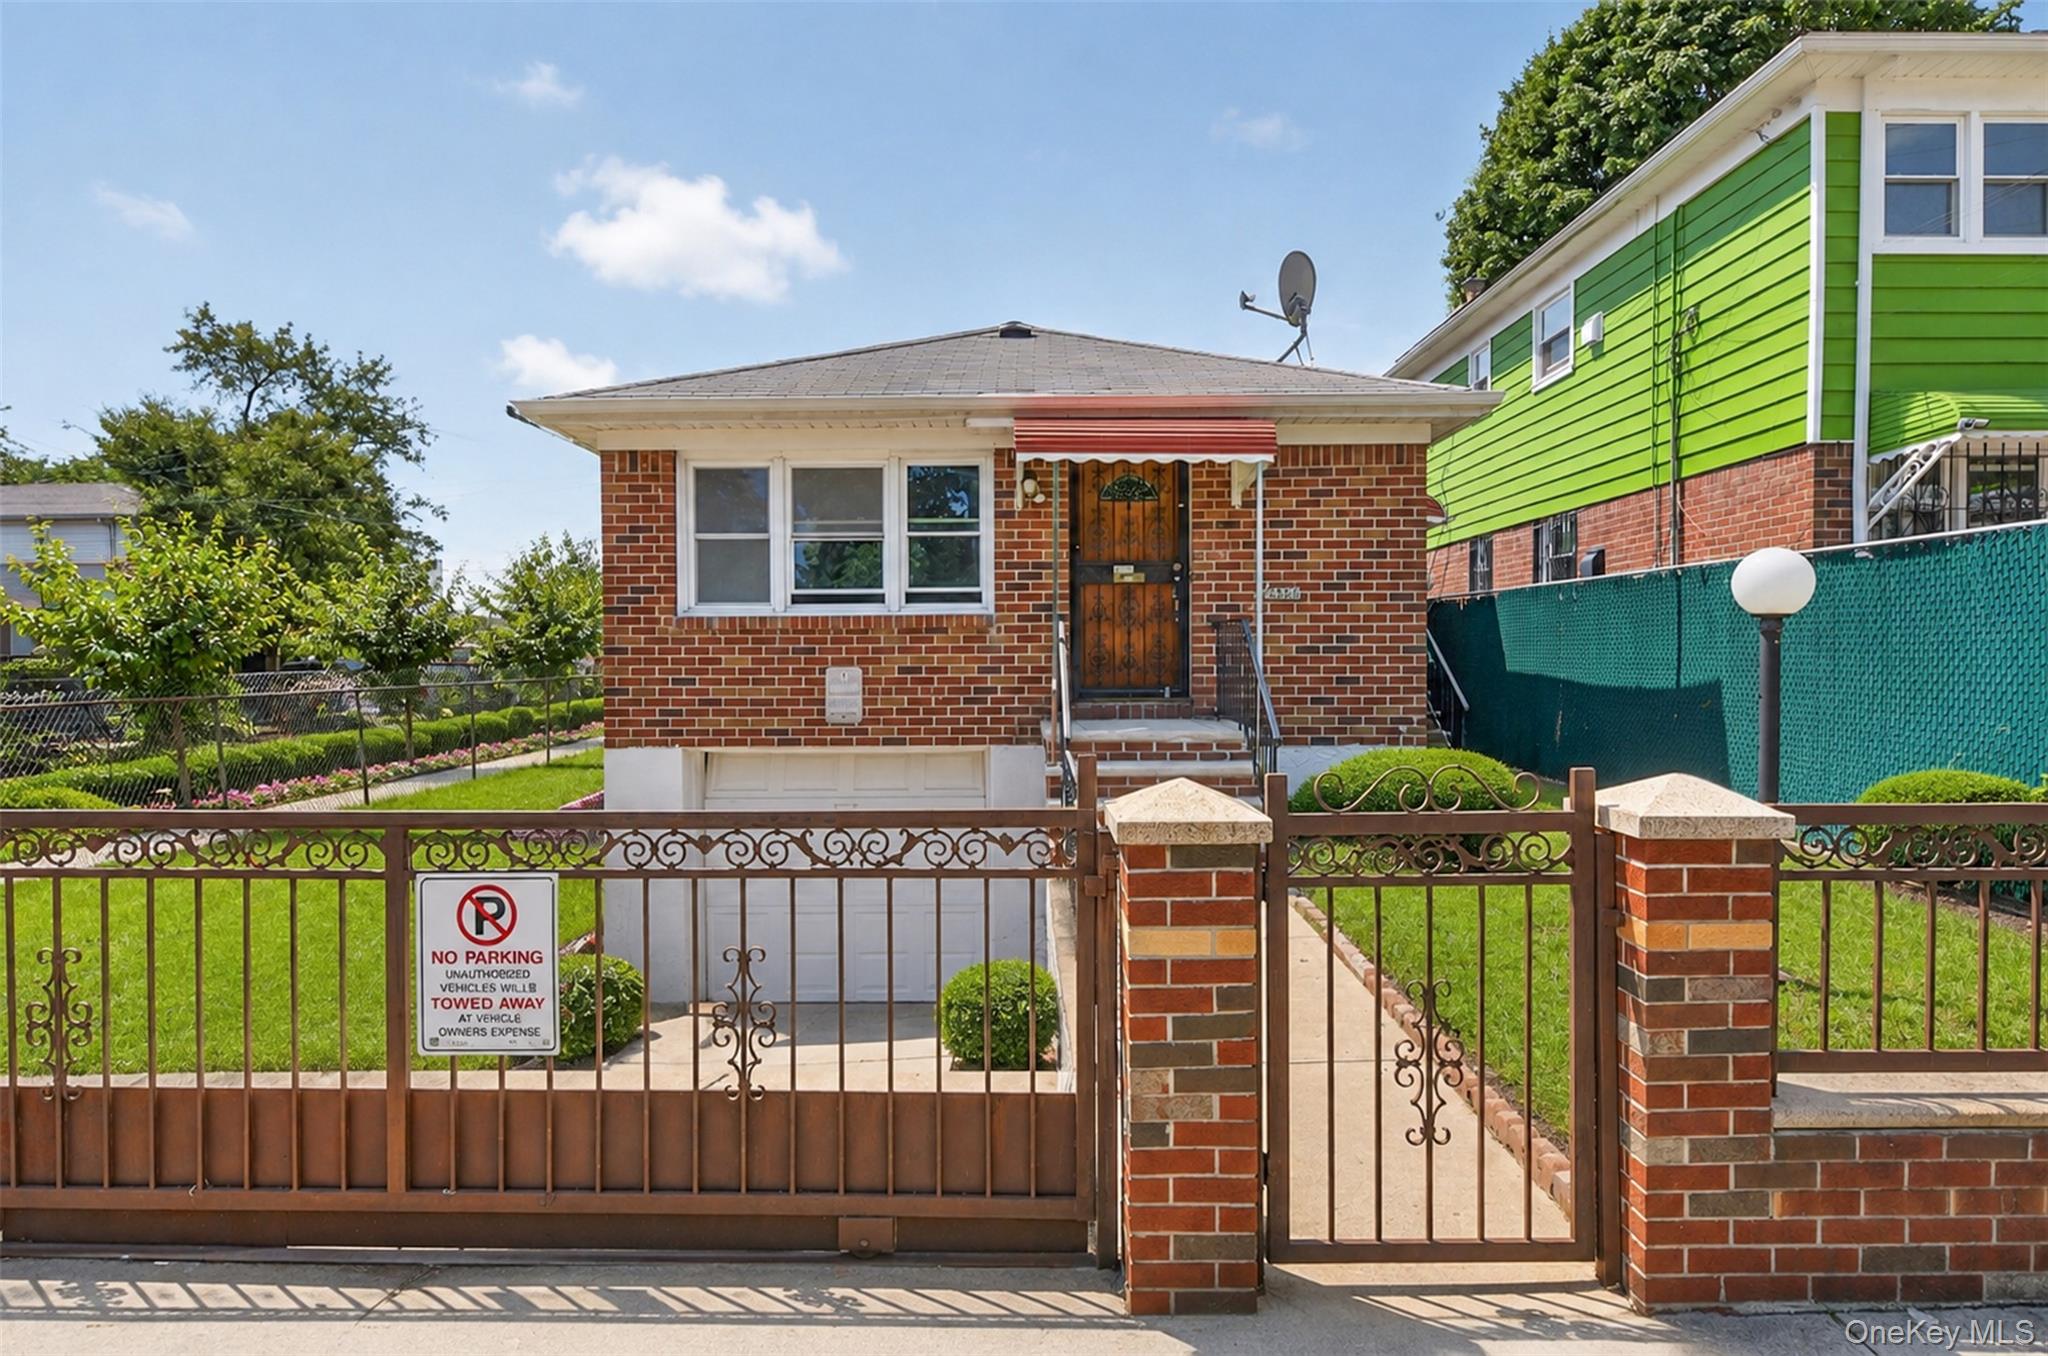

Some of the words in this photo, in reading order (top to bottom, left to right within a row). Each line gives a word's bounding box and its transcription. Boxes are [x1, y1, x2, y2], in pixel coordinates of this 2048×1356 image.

[431, 951, 458, 965] NO
[465, 951, 543, 965] PARKING
[440, 983, 496, 993] VEHICLES
[431, 997, 493, 1010] TOWED
[499, 998, 545, 1010] AWAY
[458, 1014, 473, 1023] AT
[476, 1014, 522, 1023] VEHICLE
[438, 1027, 488, 1037] OWNERS
[491, 1027, 541, 1037] EXPENSE
